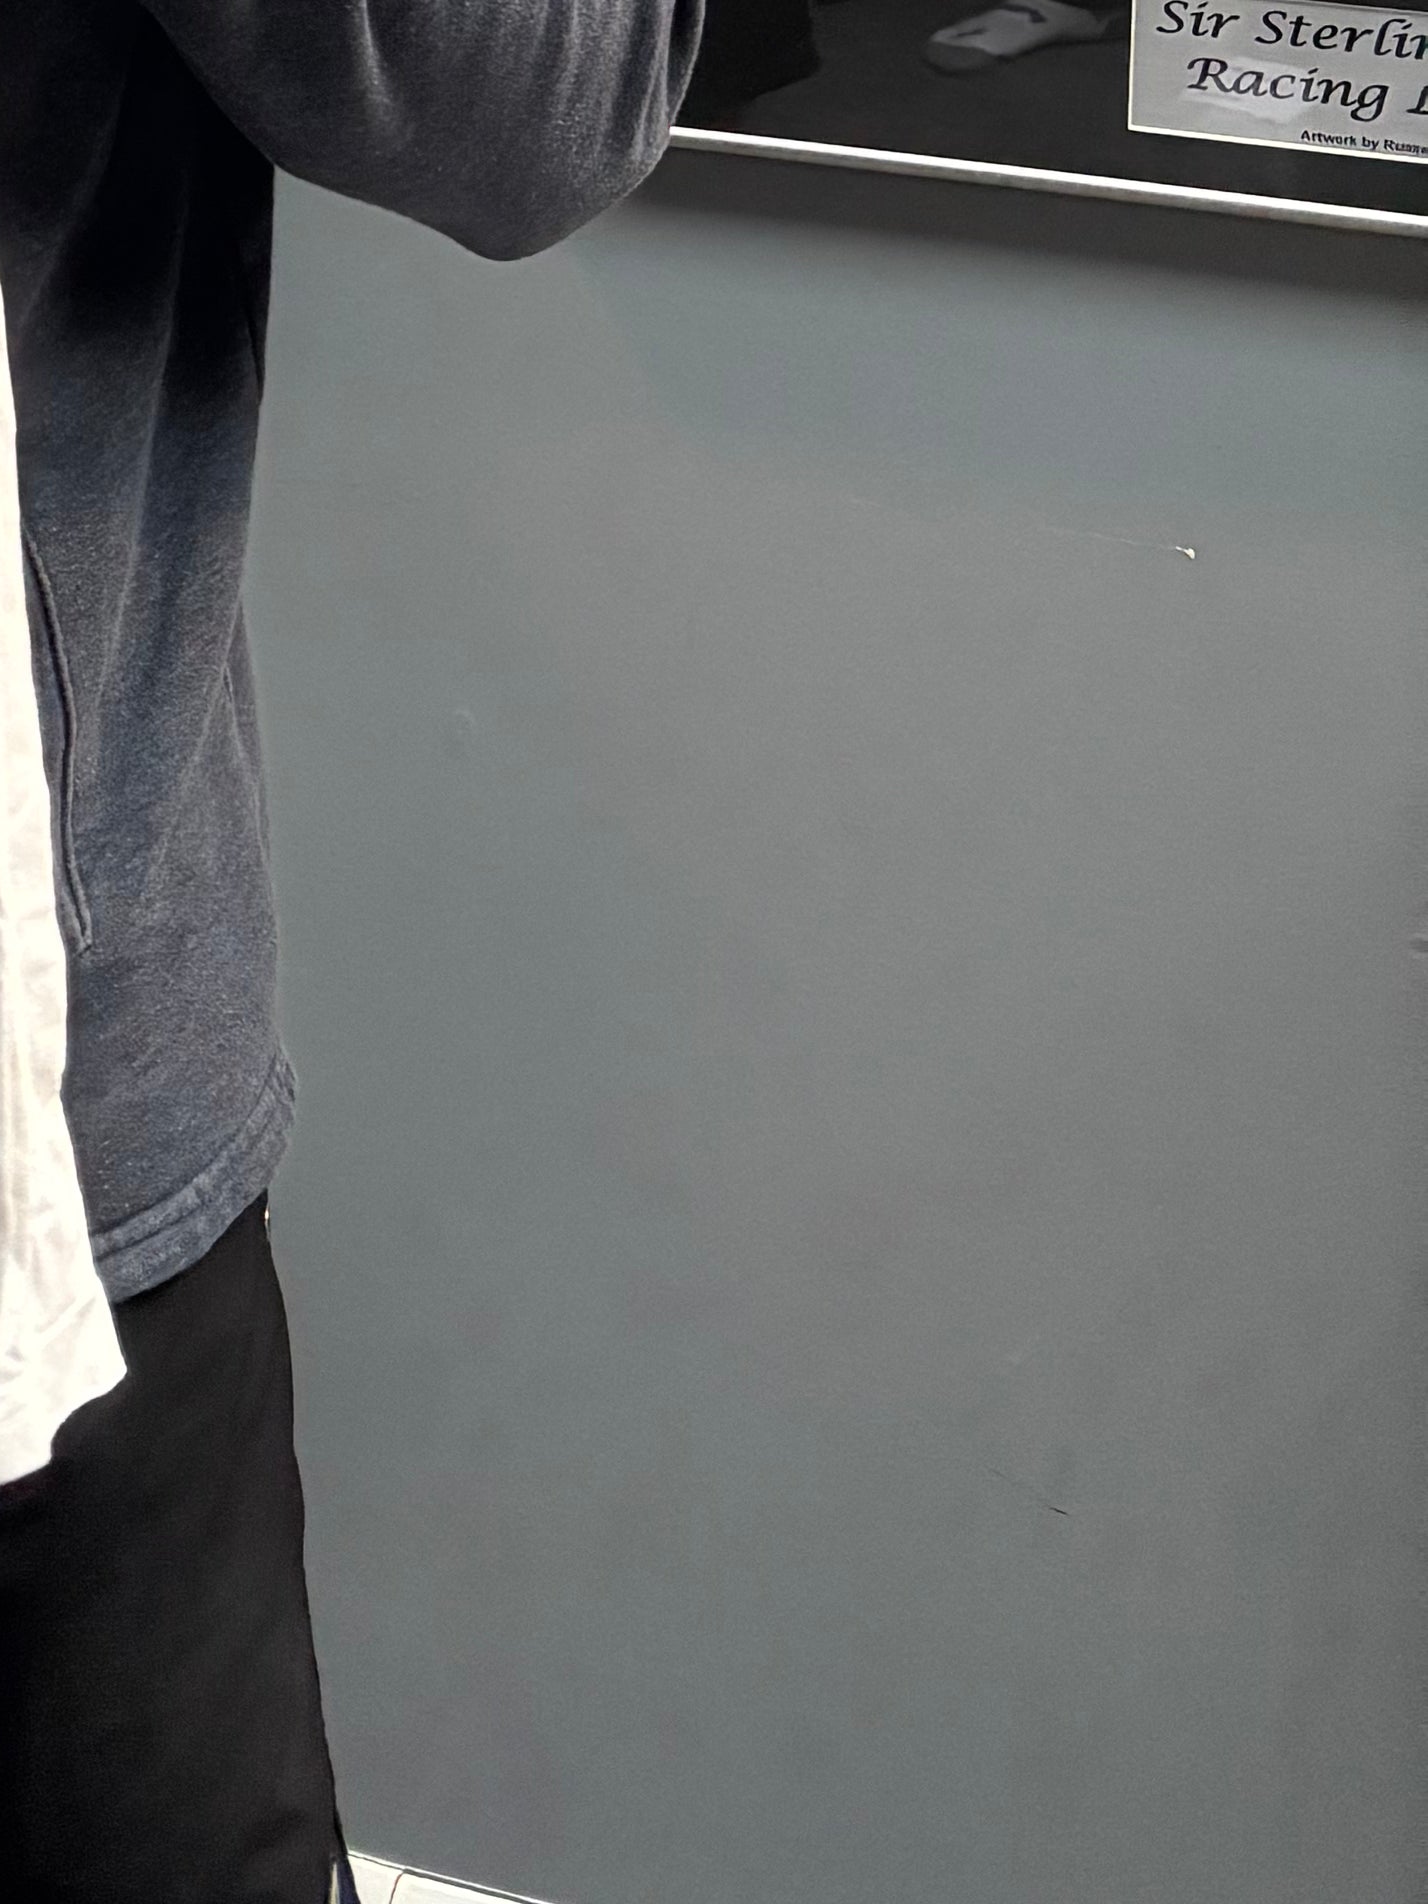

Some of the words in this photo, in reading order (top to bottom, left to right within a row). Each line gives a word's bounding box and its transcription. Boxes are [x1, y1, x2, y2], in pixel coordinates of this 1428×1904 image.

[1156, 0, 1240, 39] Sir
[1187, 57, 1390, 122] Racing
[1300, 130, 1357, 147] Artwork
[1362, 134, 1380, 151] by
